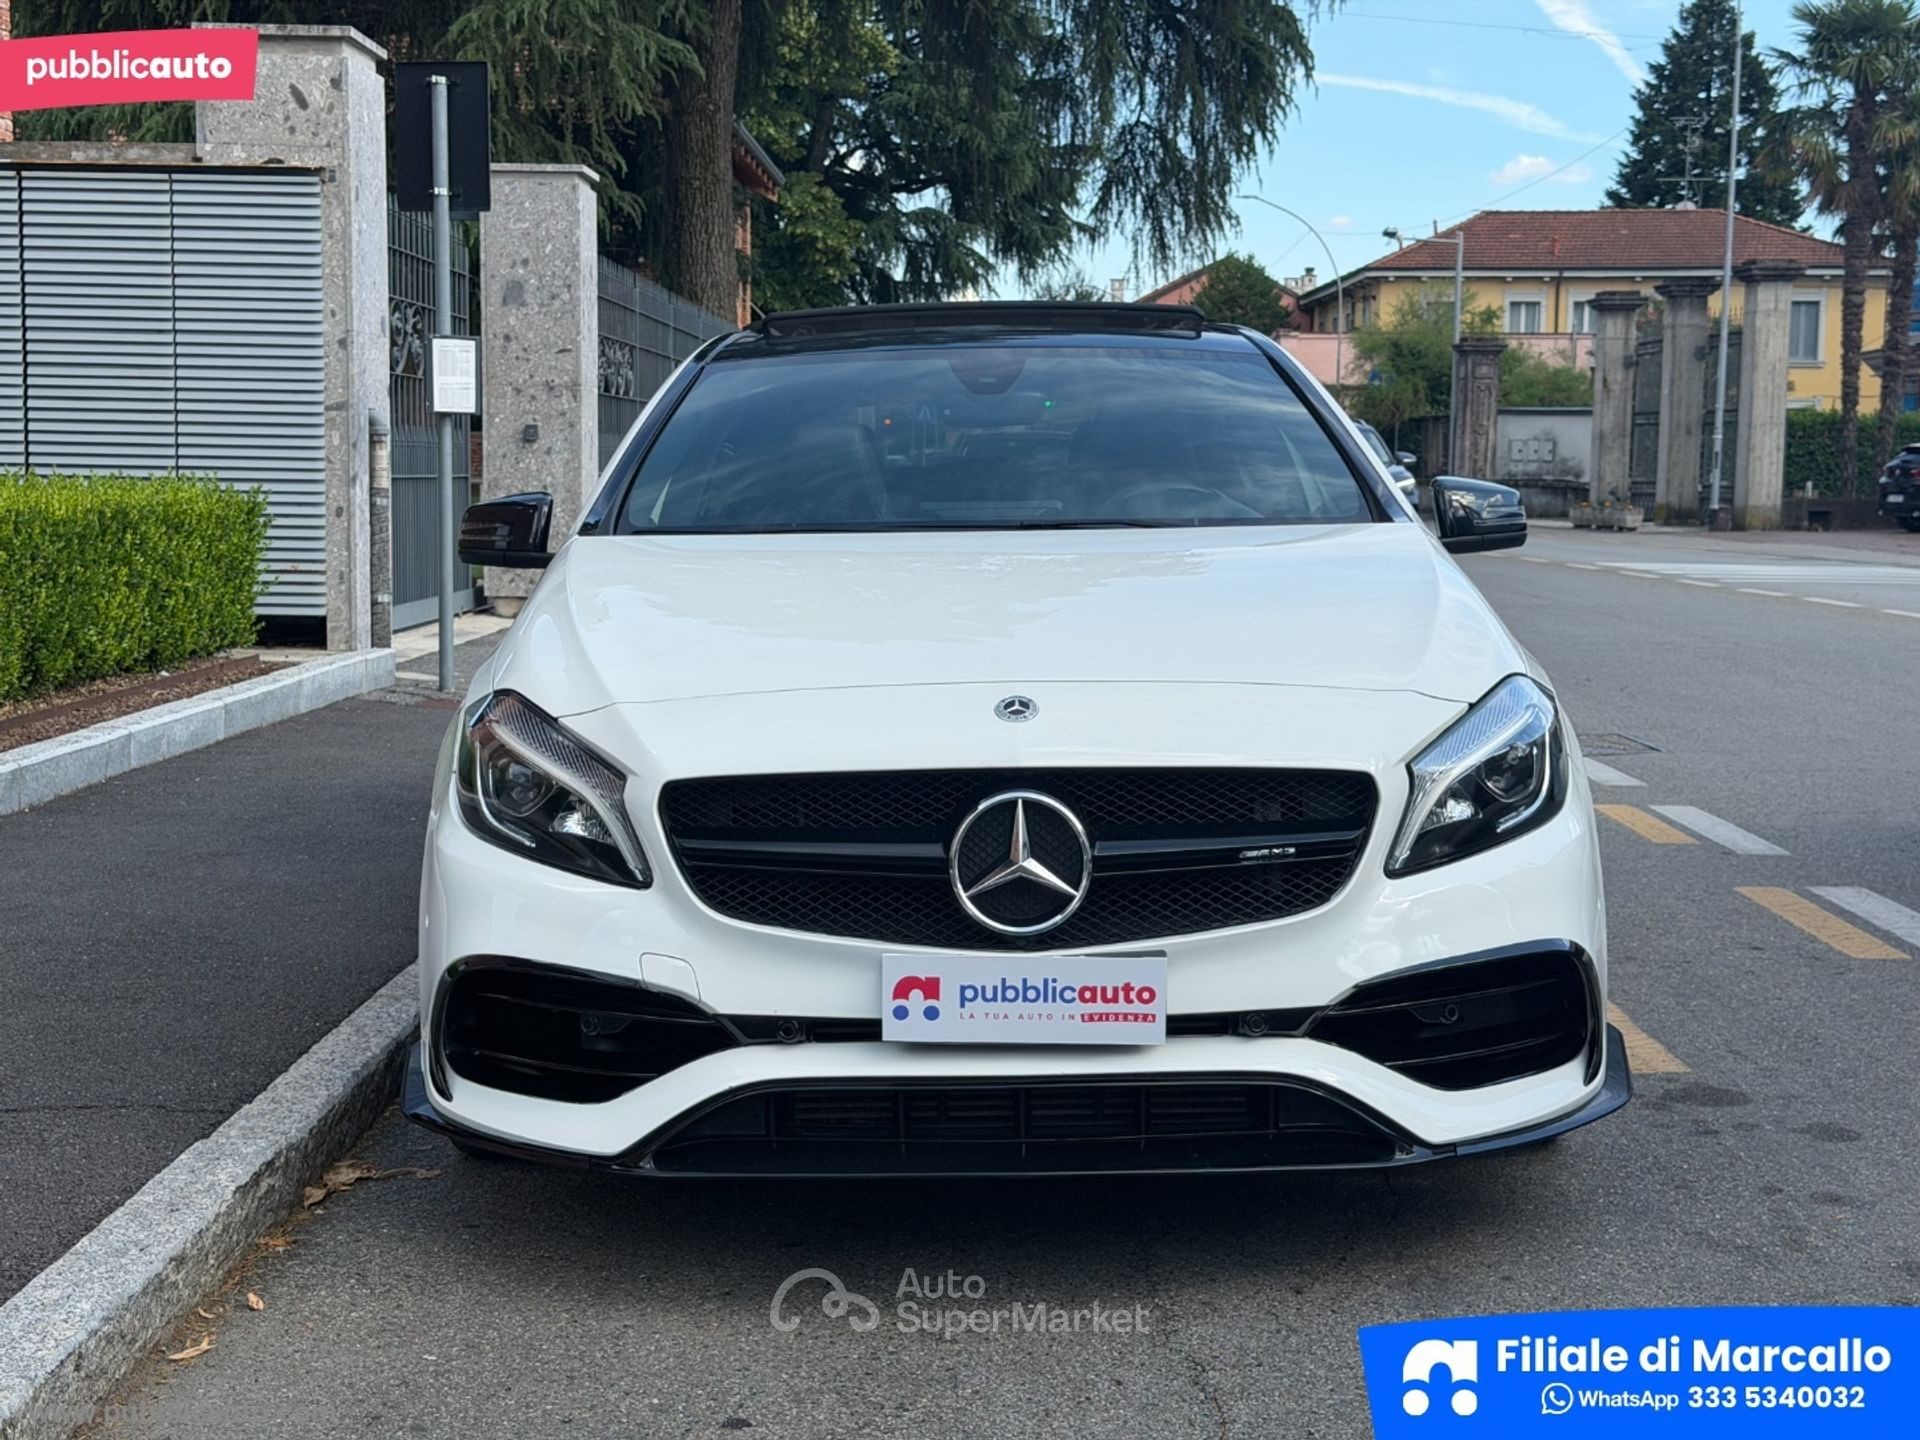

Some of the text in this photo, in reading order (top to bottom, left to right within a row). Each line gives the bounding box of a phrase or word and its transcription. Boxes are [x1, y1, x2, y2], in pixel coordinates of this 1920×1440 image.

[959, 977, 1157, 1008] pubblicauto
[959, 1012, 976, 1020] LA
[1018, 1013, 1054, 1021] AUTO
[1083, 1013, 1155, 1023] EVIDENZA
